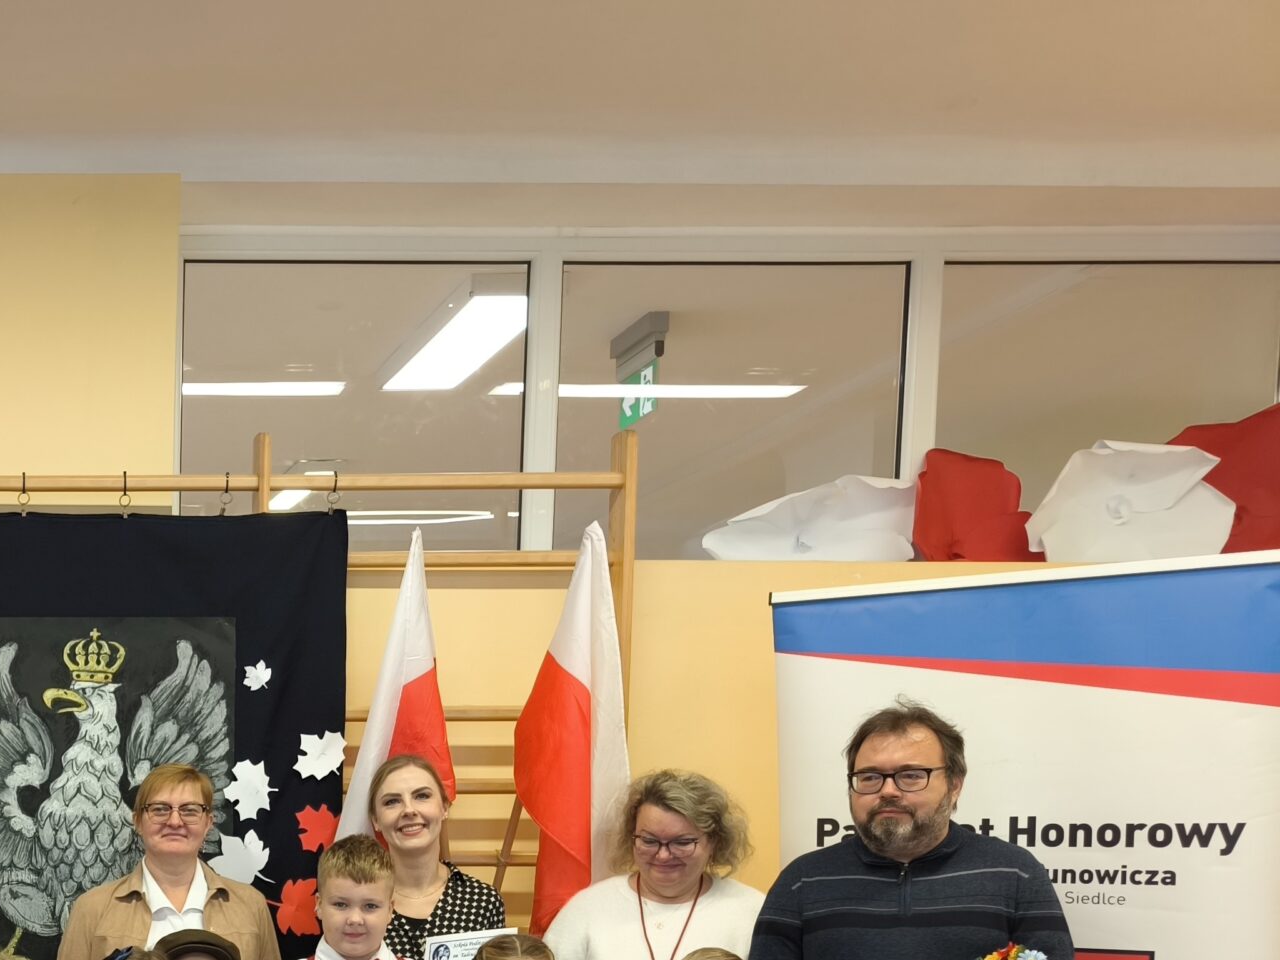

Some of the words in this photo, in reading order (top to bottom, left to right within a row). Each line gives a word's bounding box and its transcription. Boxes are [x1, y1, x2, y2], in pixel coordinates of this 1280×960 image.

[1009, 815, 1247, 856] Honorowy
[1045, 865, 1177, 886] unowicza
[1064, 890, 1126, 906] Siedlce
